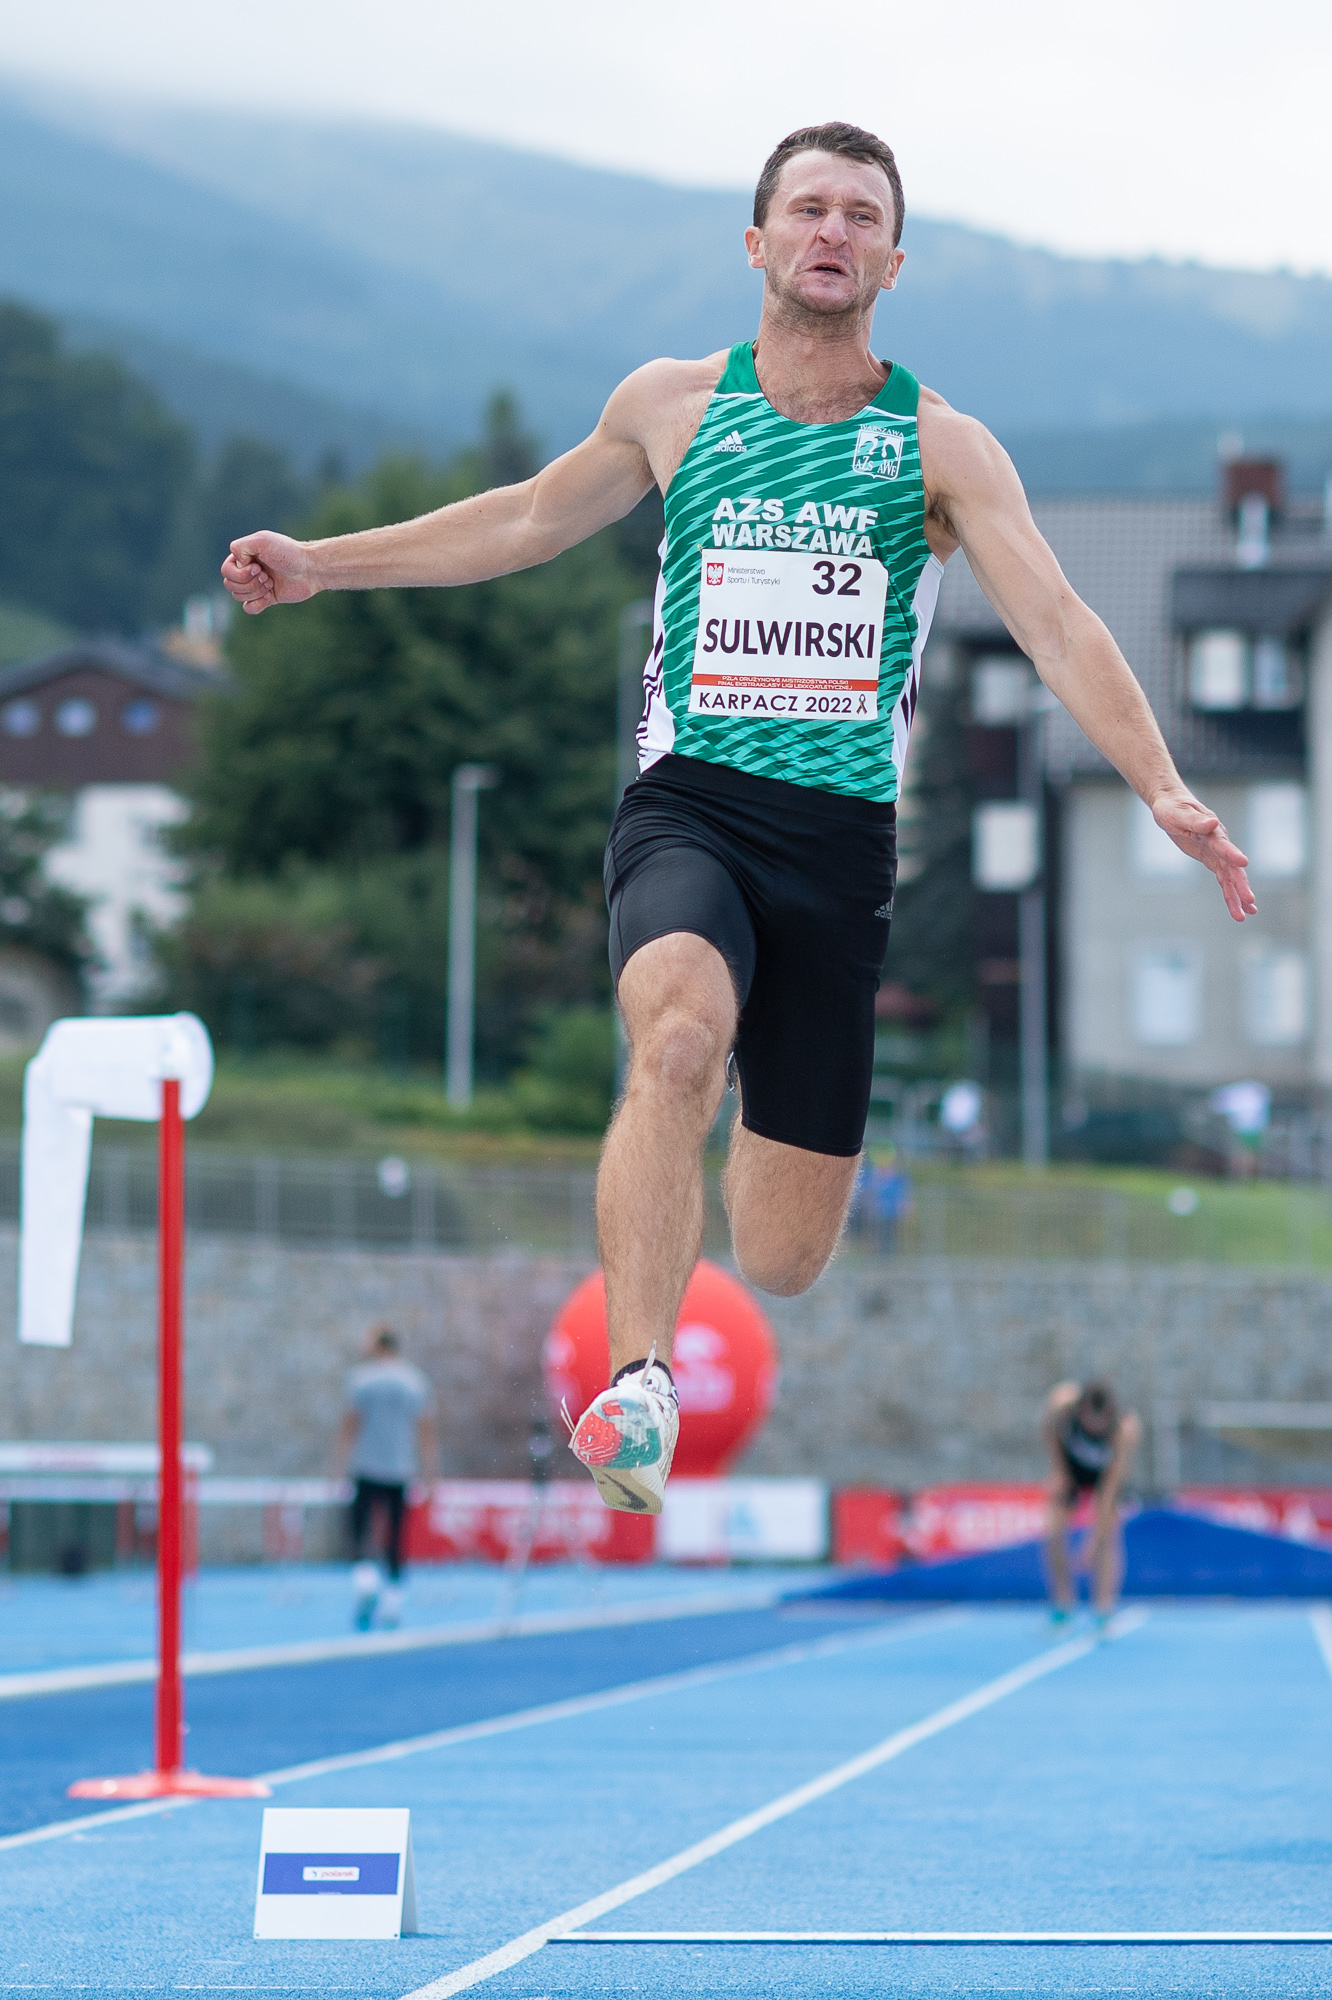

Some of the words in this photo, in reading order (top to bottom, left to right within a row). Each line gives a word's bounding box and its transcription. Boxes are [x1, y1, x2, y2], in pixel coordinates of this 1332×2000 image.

[859, 423, 905, 438] WARSZAWA
[714, 443, 748, 453] adidas
[854, 455, 874, 472] AZS
[877, 459, 897, 477] AWF
[712, 497, 785, 522] AZS
[794, 501, 879, 532] AWF
[711, 523, 874, 557] WARSZAWA
[726, 576, 747, 585] Sportu
[751, 577, 781, 586] Turystyki
[727, 566, 766, 576] Ministerstwo
[811, 560, 863, 597] 32
[702, 618, 876, 659] SULWIRSKI
[698, 692, 799, 712] KARPACZ
[804, 696, 852, 713] 2022
